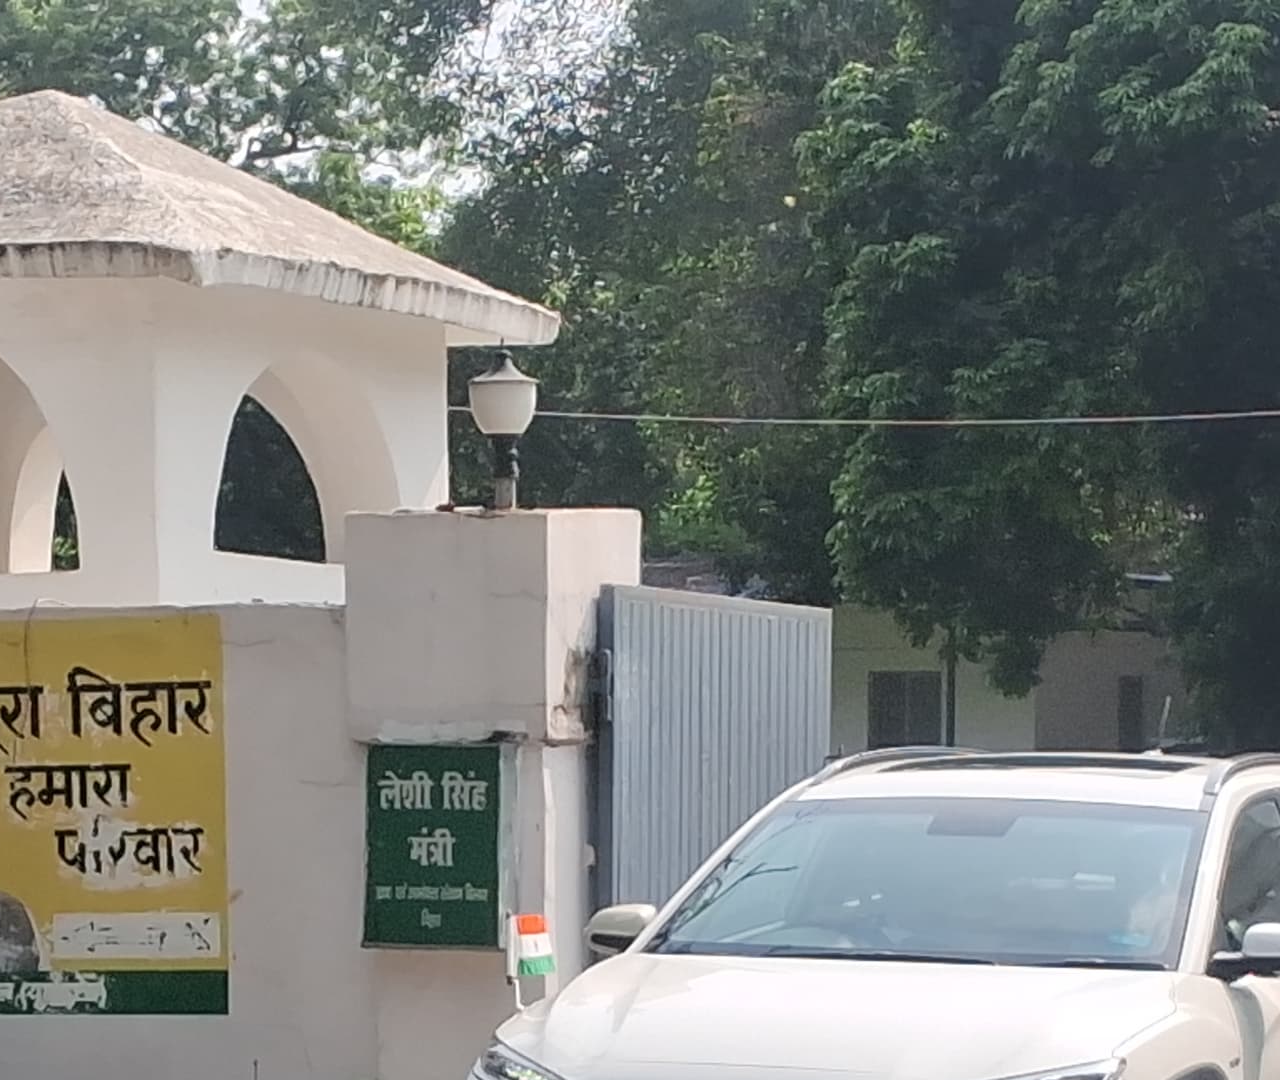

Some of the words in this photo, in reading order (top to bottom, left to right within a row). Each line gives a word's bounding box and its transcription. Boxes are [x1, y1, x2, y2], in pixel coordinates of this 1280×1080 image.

[67, 667, 211, 746] बिहार
[4, 763, 131, 818] हमारा
[377, 770, 434, 810] लेशी
[440, 770, 488, 811] सिंह
[407, 827, 456, 866] मंत्री
